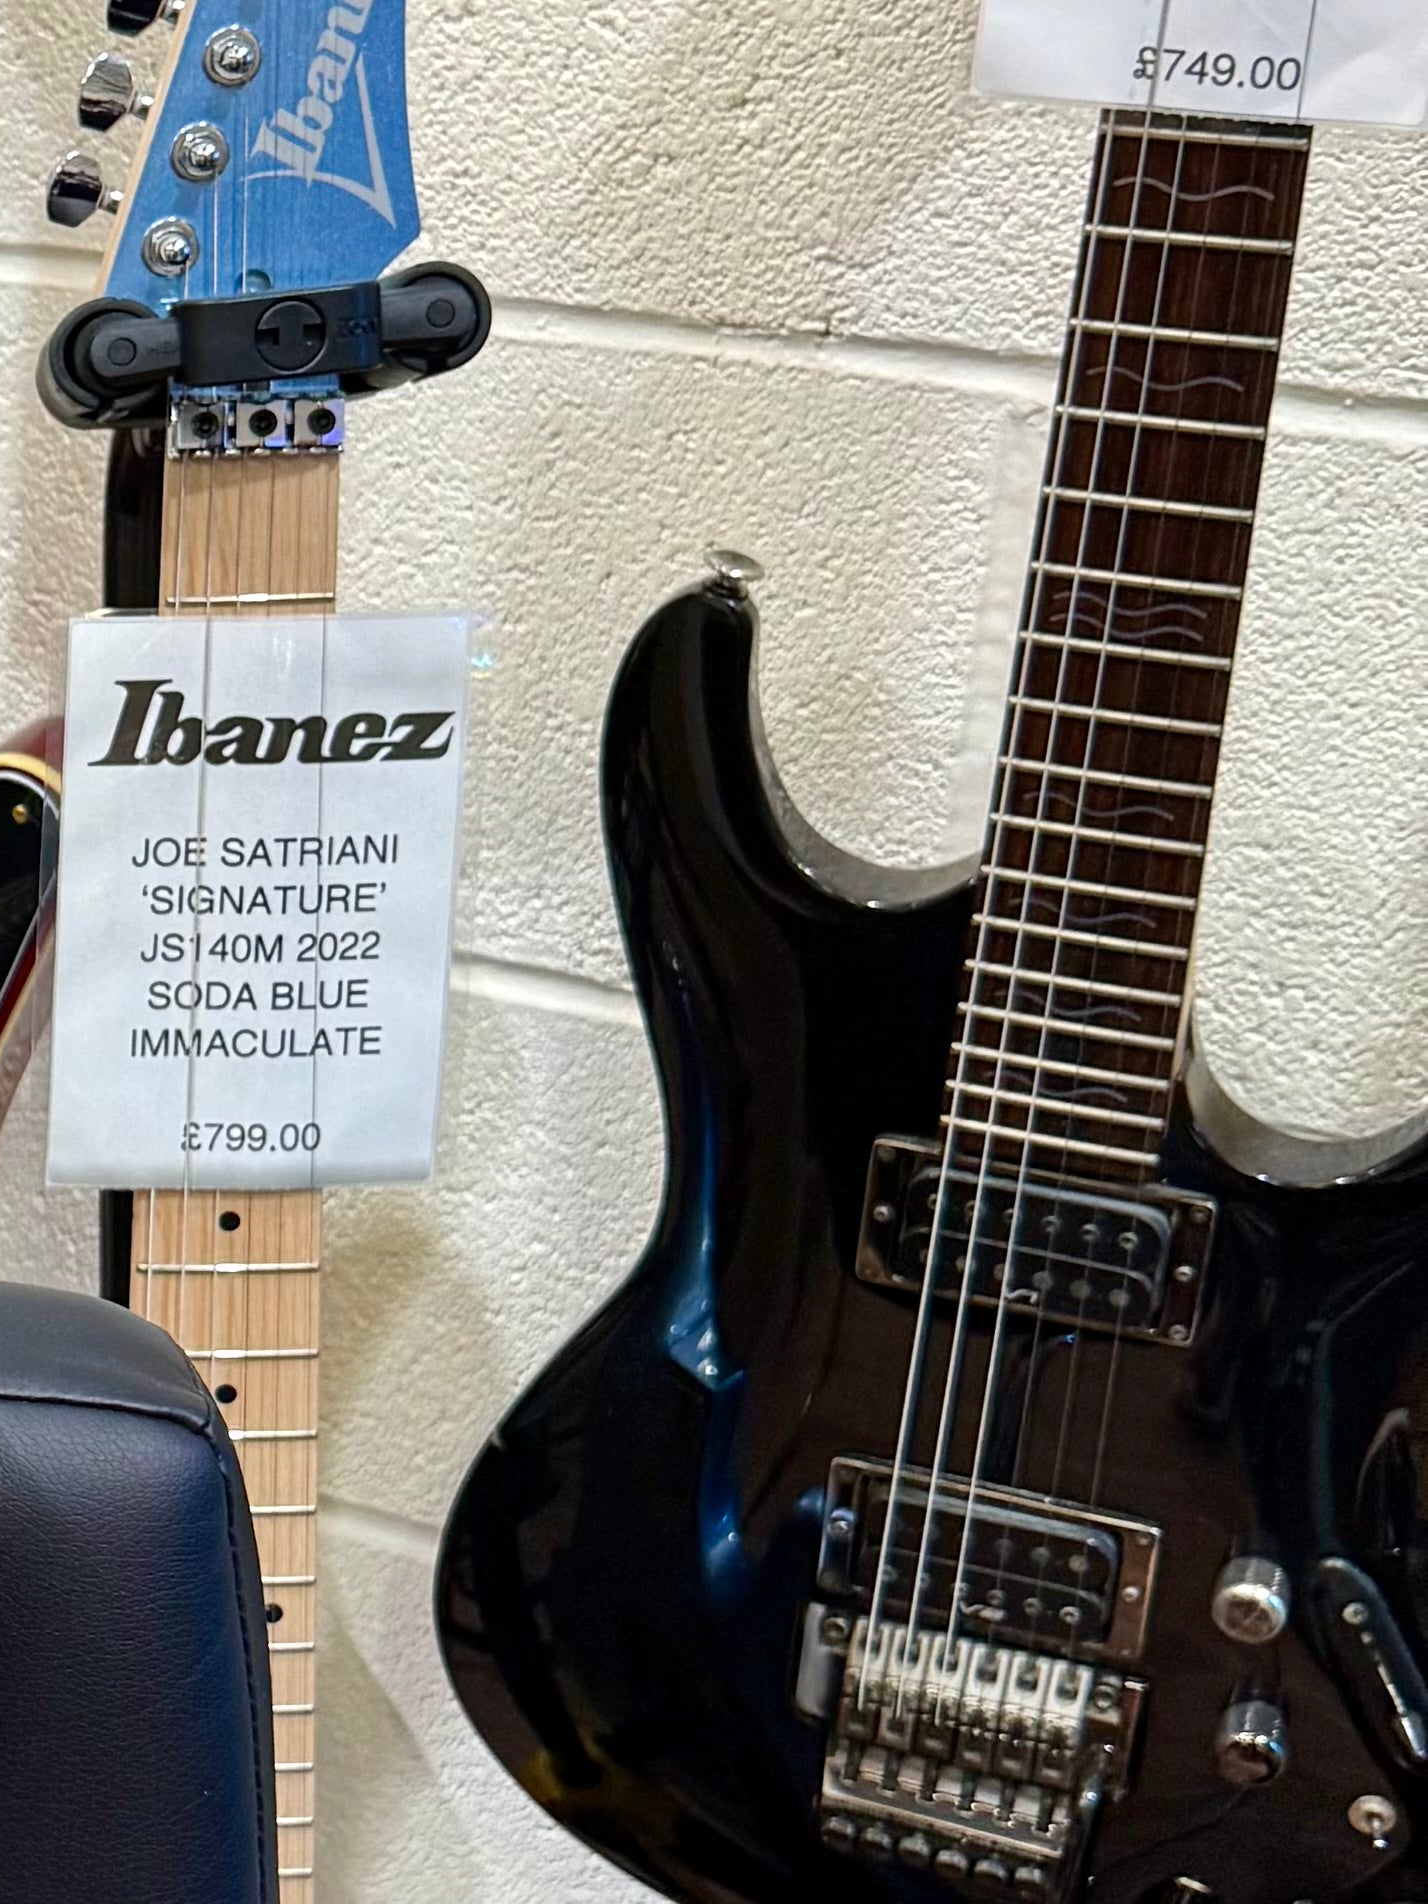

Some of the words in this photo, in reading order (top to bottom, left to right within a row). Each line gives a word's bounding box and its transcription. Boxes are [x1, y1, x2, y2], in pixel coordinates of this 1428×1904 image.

[1133, 47, 1302, 91] £749.00
[87, 679, 456, 767] Ibanez
[131, 837, 207, 868] JOE
[220, 834, 398, 867] SATRIANI
[140, 933, 283, 964] JS140M
[296, 931, 381, 963] 2022
[147, 981, 258, 1010] SODA
[271, 979, 369, 1010] BLUE
[130, 1026, 382, 1059] IMMACULATE
[181, 1122, 321, 1153] £799.00
